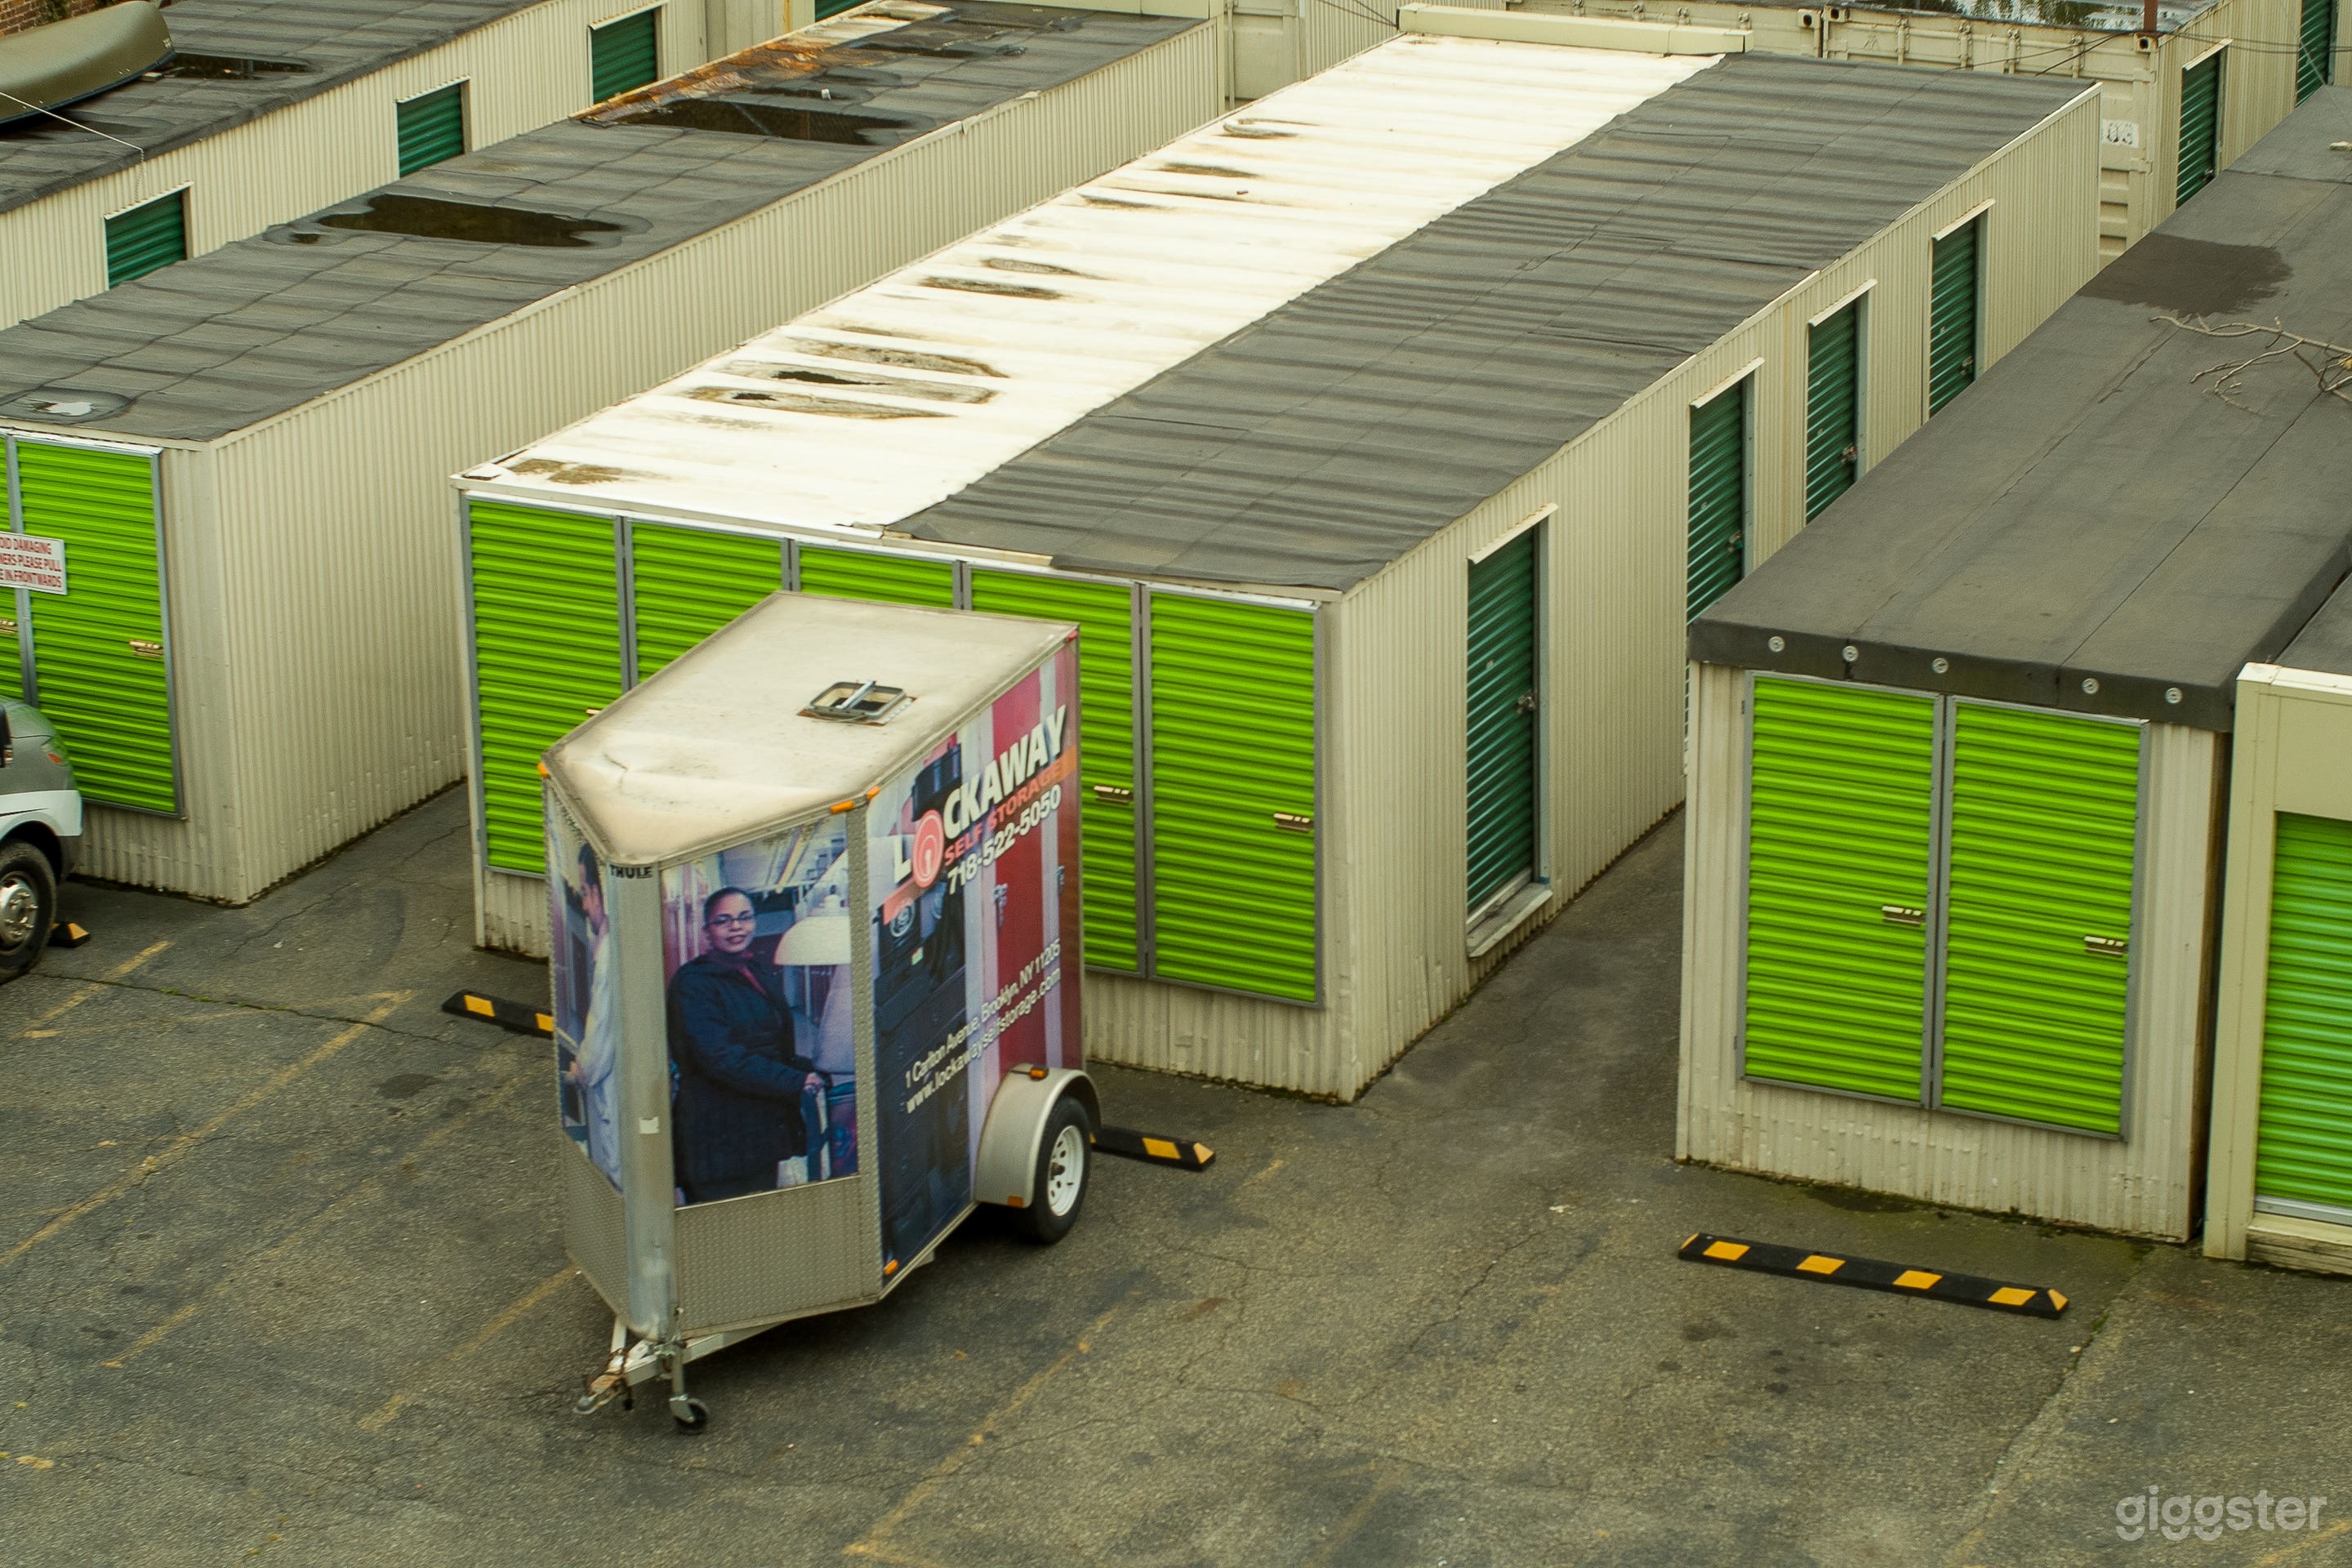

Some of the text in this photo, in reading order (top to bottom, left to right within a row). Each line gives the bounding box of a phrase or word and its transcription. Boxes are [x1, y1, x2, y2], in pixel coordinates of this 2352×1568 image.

[18, 555, 43, 569] PLEASE
[44, 558, 62, 572] PULL
[893, 705, 1066, 888] LOCKAWAY
[944, 764, 1062, 866] SELF STORAGE
[947, 784, 1061, 895] 718-522-5050
[609, 864, 653, 880] THULE
[905, 1070, 911, 1089] 1
[912, 1045, 946, 1082] Carlton
[1019, 960, 1036, 989] NY
[906, 968, 1061, 1114] www.lockawayselfstorage.com
